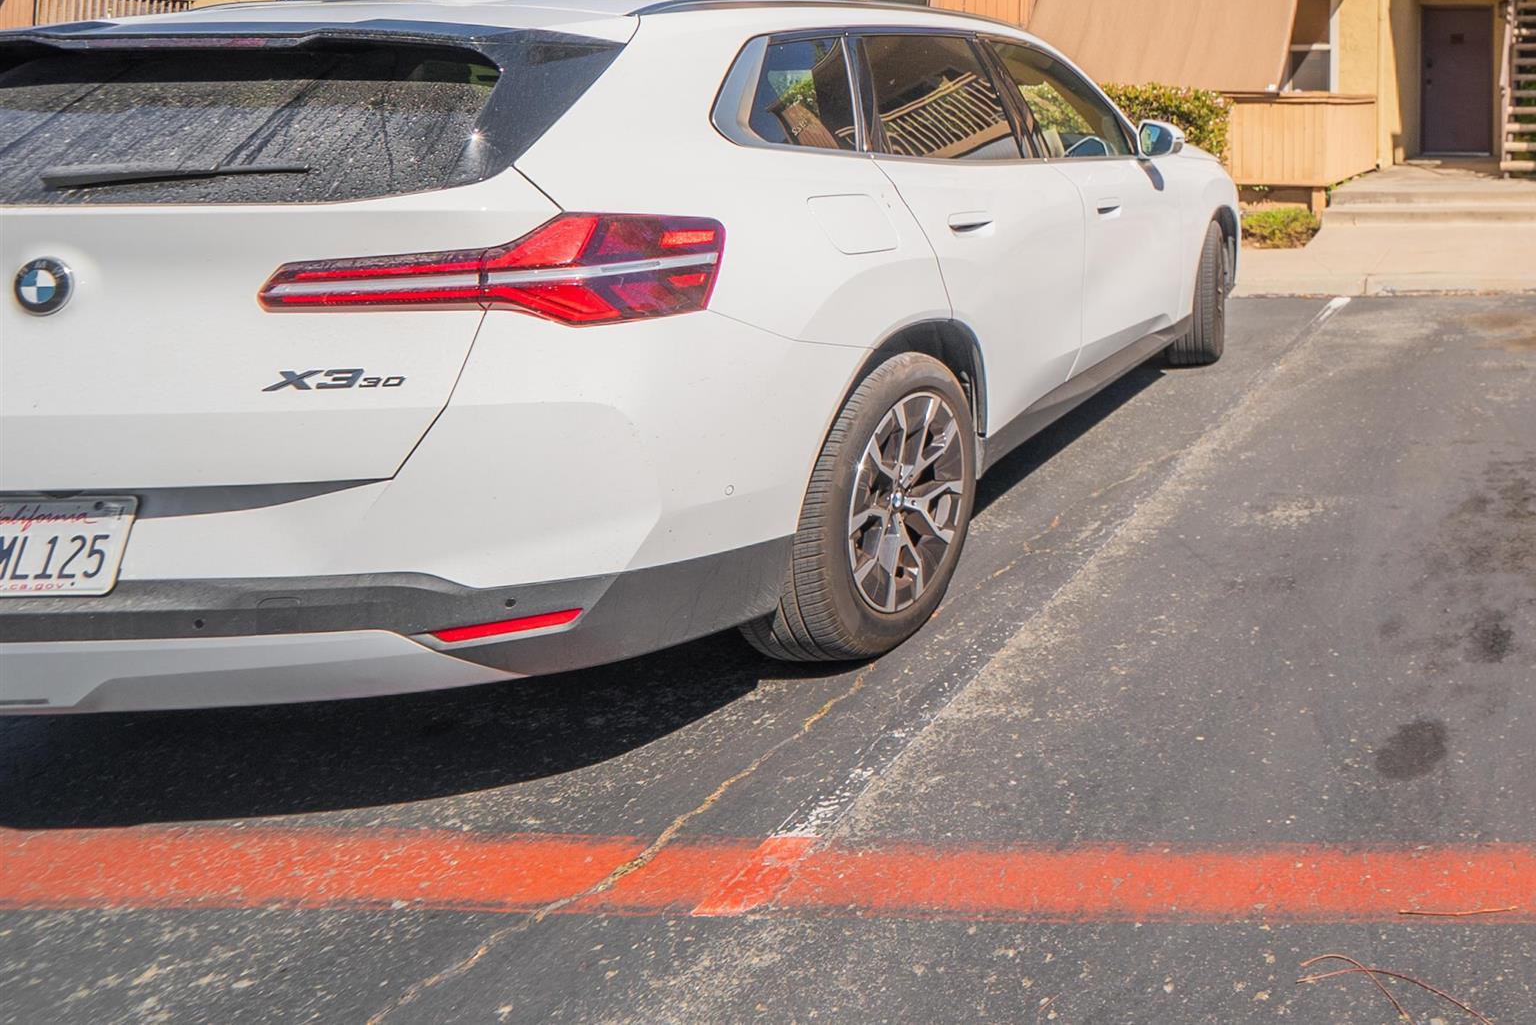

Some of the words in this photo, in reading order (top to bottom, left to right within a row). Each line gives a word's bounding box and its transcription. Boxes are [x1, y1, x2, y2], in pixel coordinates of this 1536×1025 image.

[262, 368, 365, 392] X3
[358, 376, 407, 388] 30
[0, 504, 97, 532] alifornia
